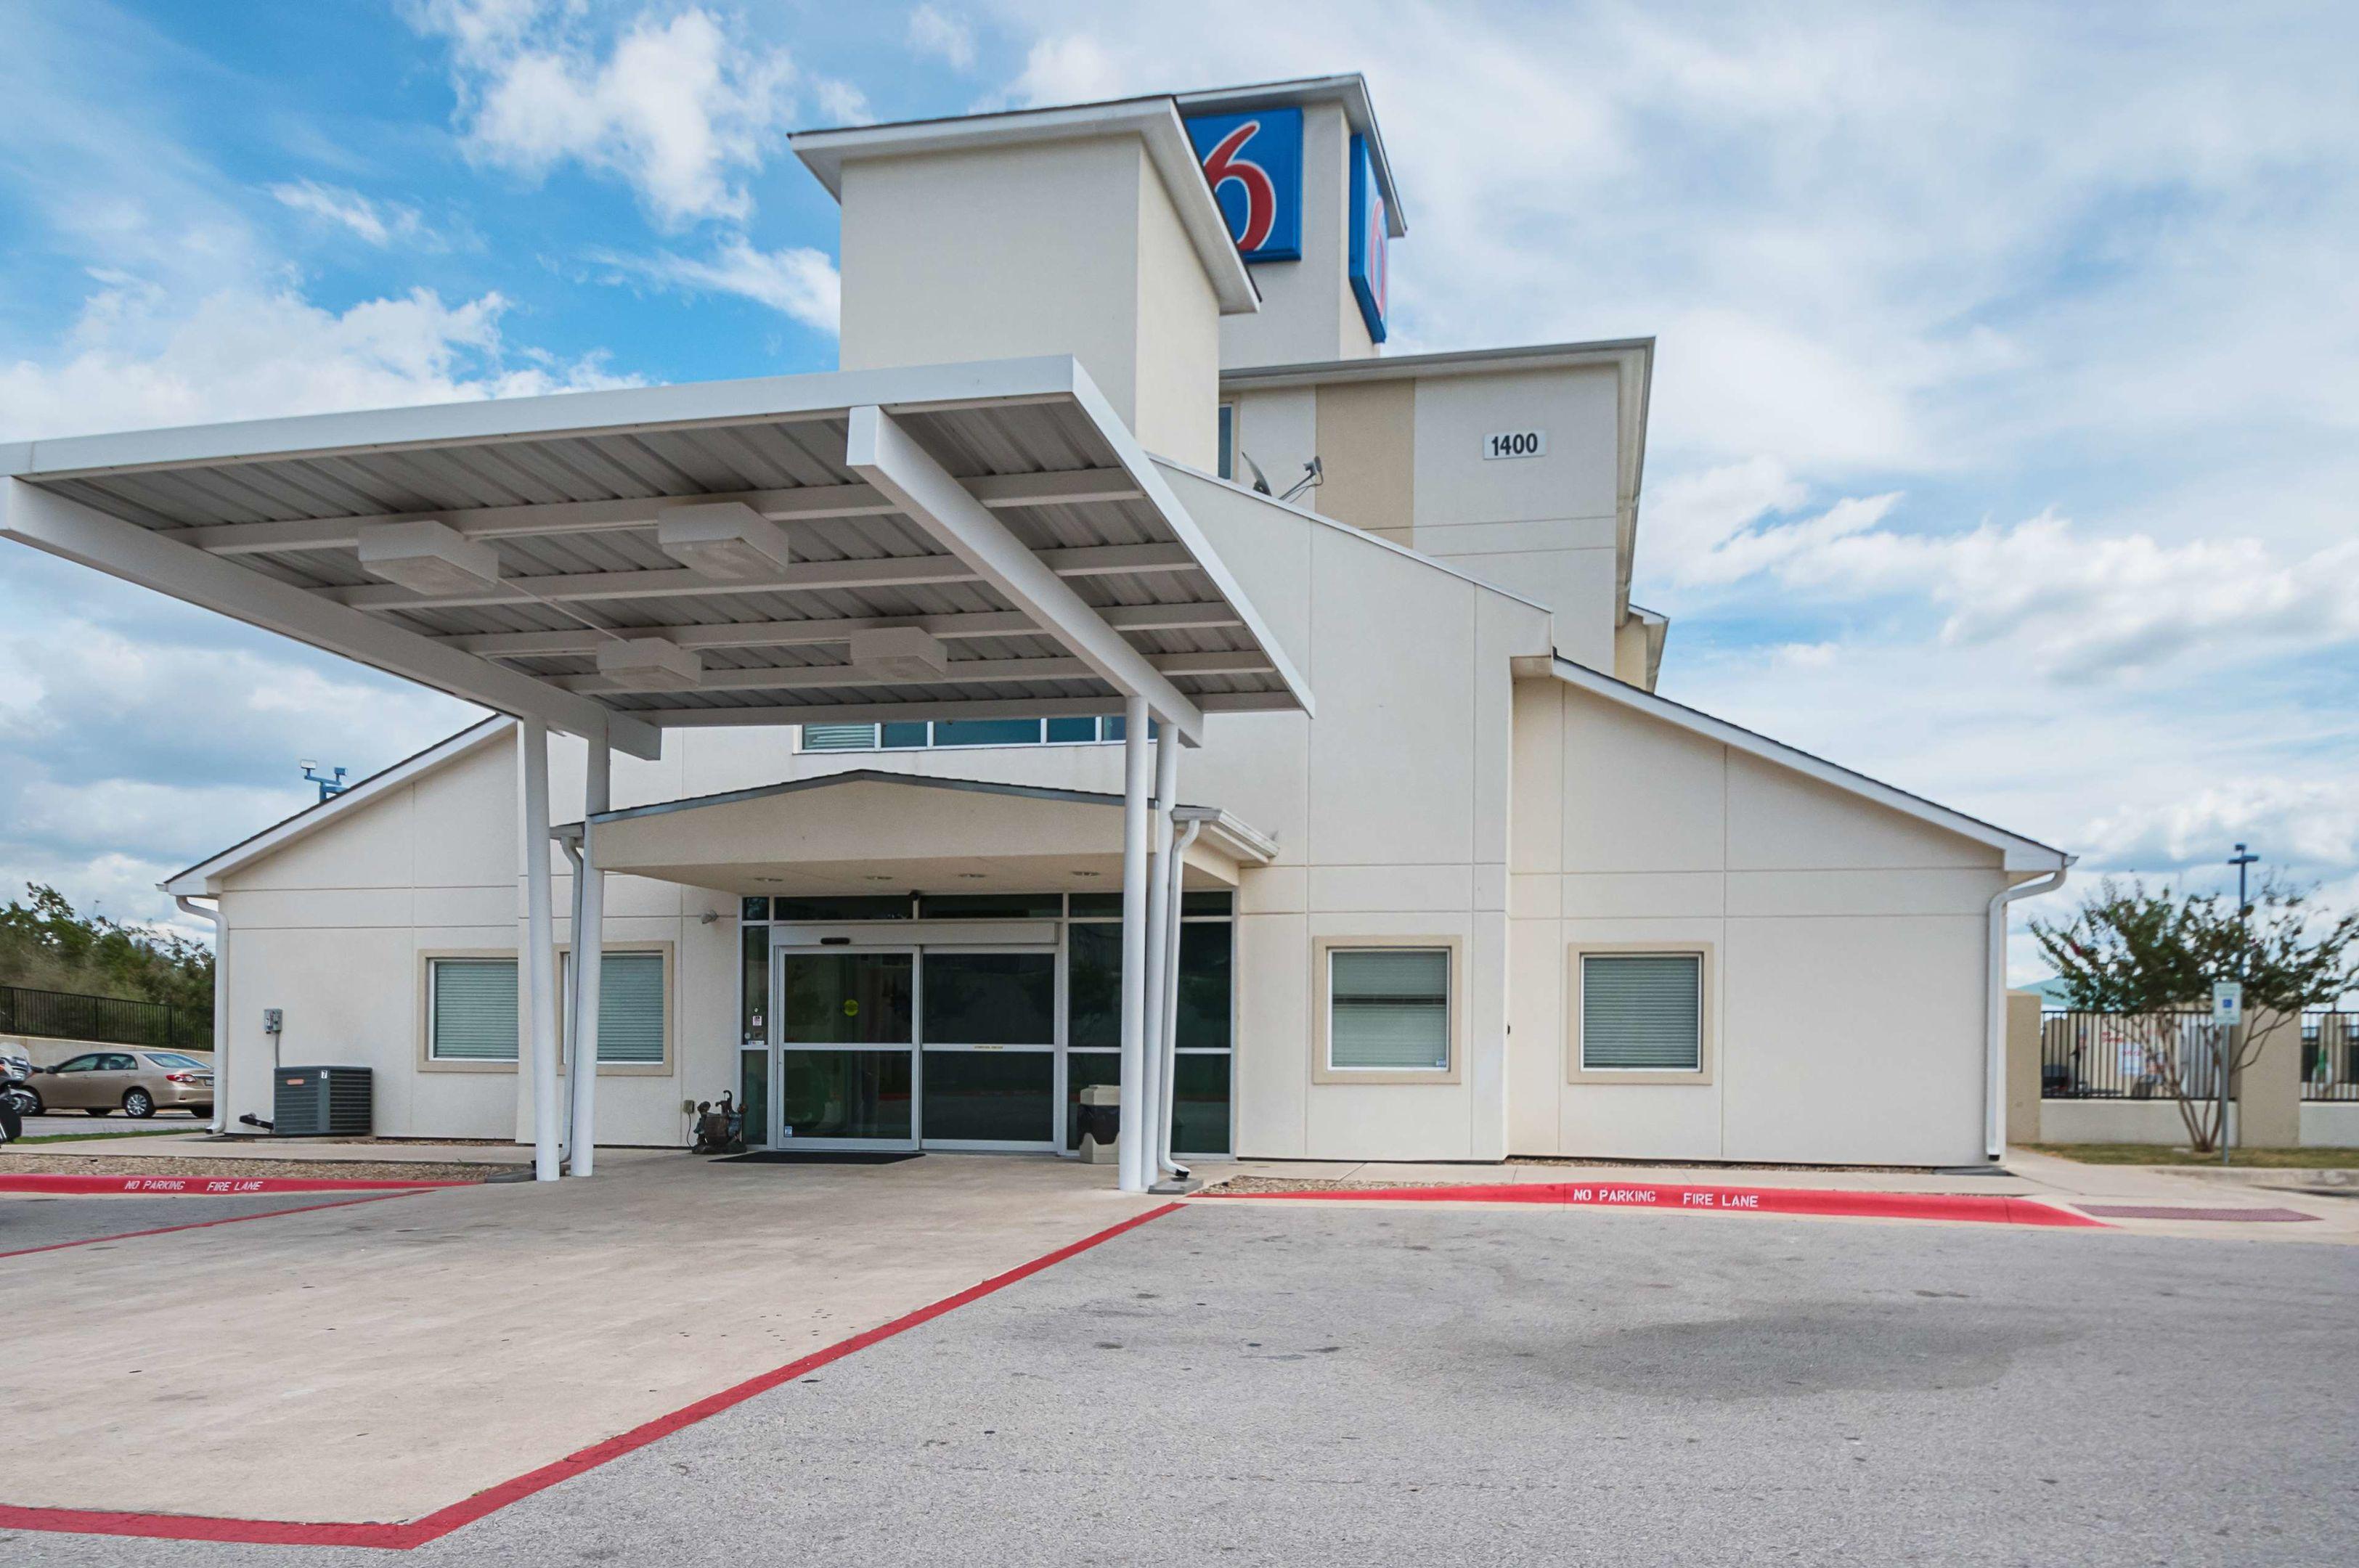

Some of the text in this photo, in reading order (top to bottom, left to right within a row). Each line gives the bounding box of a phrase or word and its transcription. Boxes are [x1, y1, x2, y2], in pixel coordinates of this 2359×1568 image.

[1203, 119, 1276, 251] 6
[1371, 196, 1385, 319] 6
[1491, 433, 1538, 456] 1400
[125, 1180, 263, 1191] NO PARKING FIRE LANE
[1573, 1189, 1759, 1208] NO PARKING FIRE LANE
